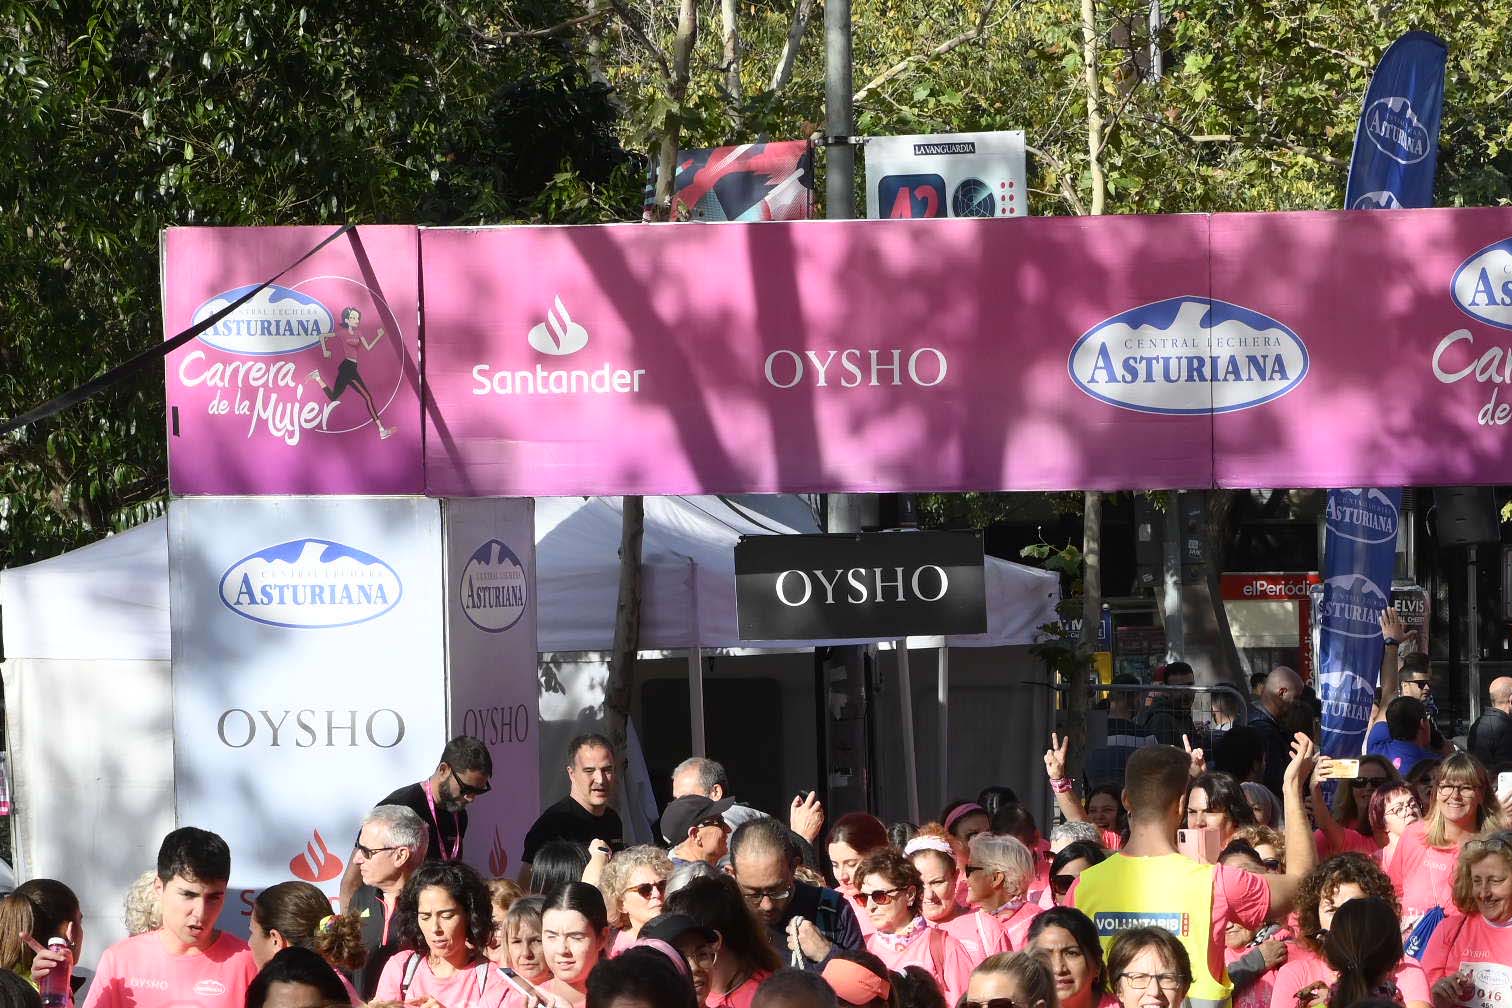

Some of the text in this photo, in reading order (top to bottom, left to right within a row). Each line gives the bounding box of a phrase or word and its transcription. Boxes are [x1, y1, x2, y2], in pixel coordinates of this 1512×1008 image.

[924, 142, 975, 154] VANGUARDIA
[1124, 336, 1281, 348] CENTRAL LECHERA
[179, 351, 296, 389] Carrera
[472, 364, 645, 396] Santander
[764, 347, 948, 389] OYSHO
[1086, 341, 1289, 385] ASTURIANA
[208, 384, 341, 446] de la Mujer
[1477, 386, 1512, 426] de
[233, 572, 389, 607] ASTURIANA
[466, 574, 524, 610] ASTURIANA
[774, 564, 949, 607] OYSHO
[217, 708, 406, 748] OYSHO
[1476, 988, 1502, 1001] 016
